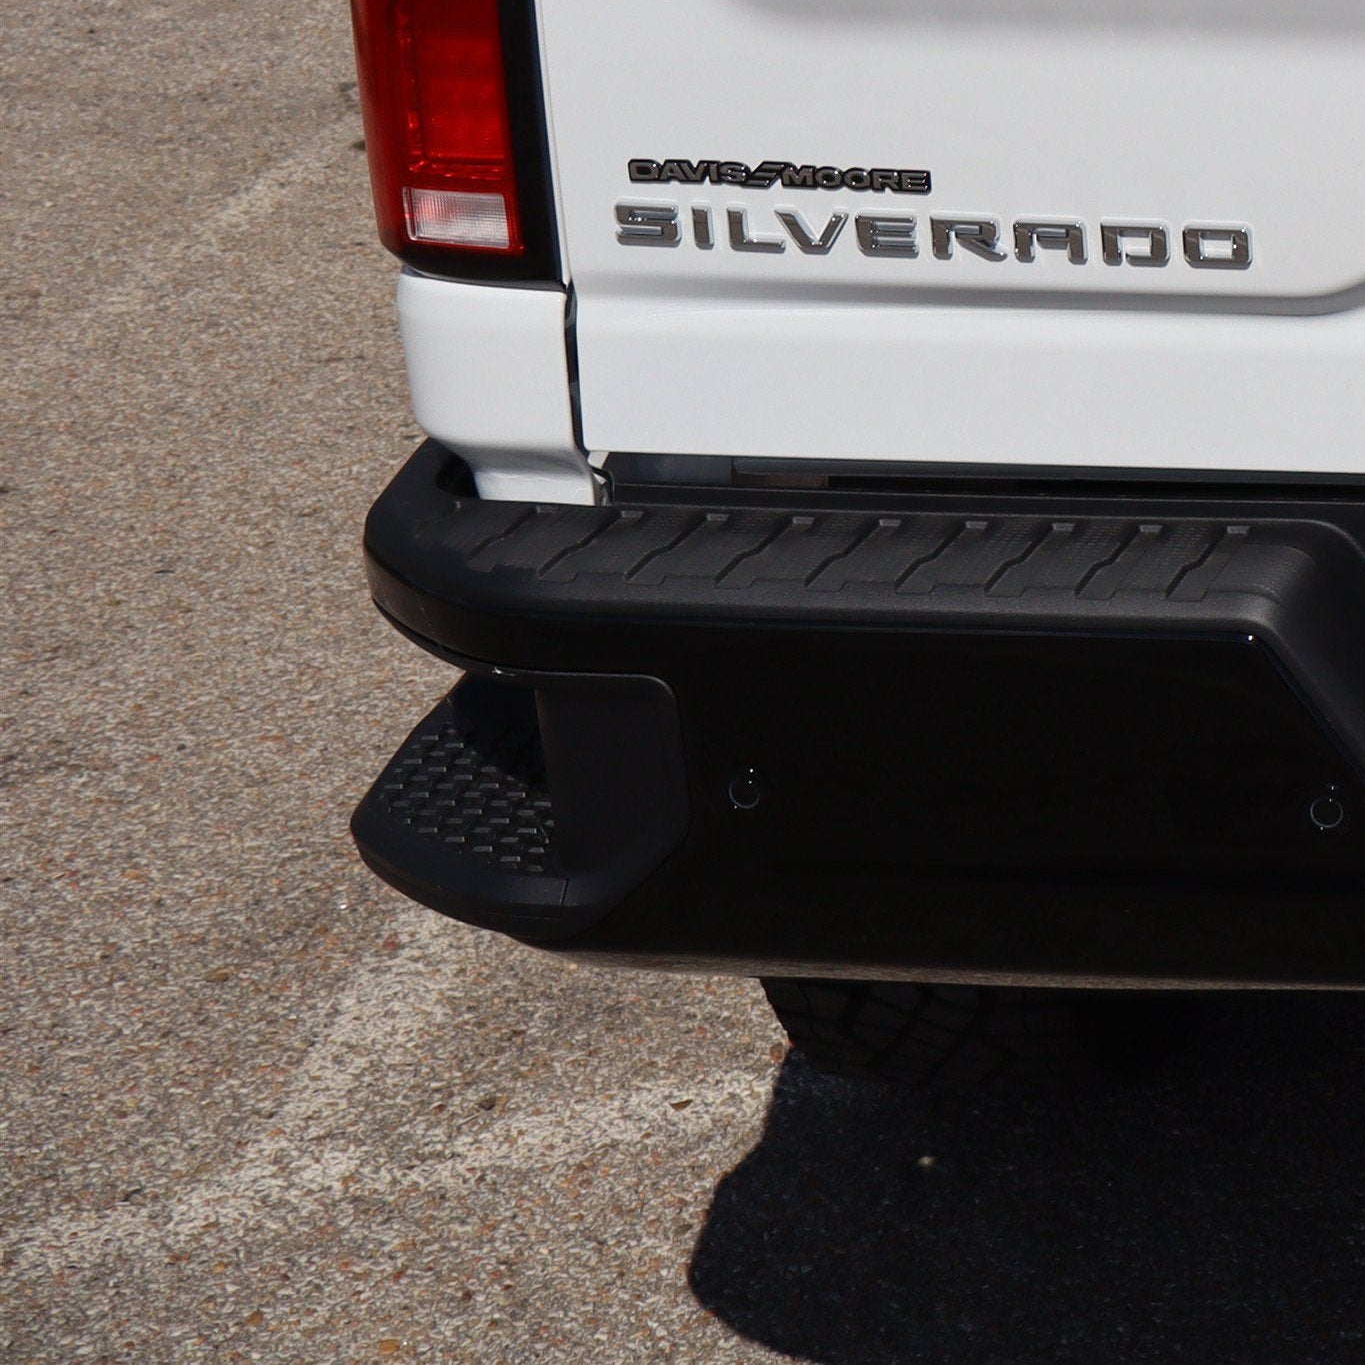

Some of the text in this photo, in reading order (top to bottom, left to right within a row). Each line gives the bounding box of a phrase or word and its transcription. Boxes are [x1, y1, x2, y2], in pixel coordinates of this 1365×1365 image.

[627, 158, 932, 195] DAVIS MOORE
[613, 201, 1253, 270] SILVERADO
